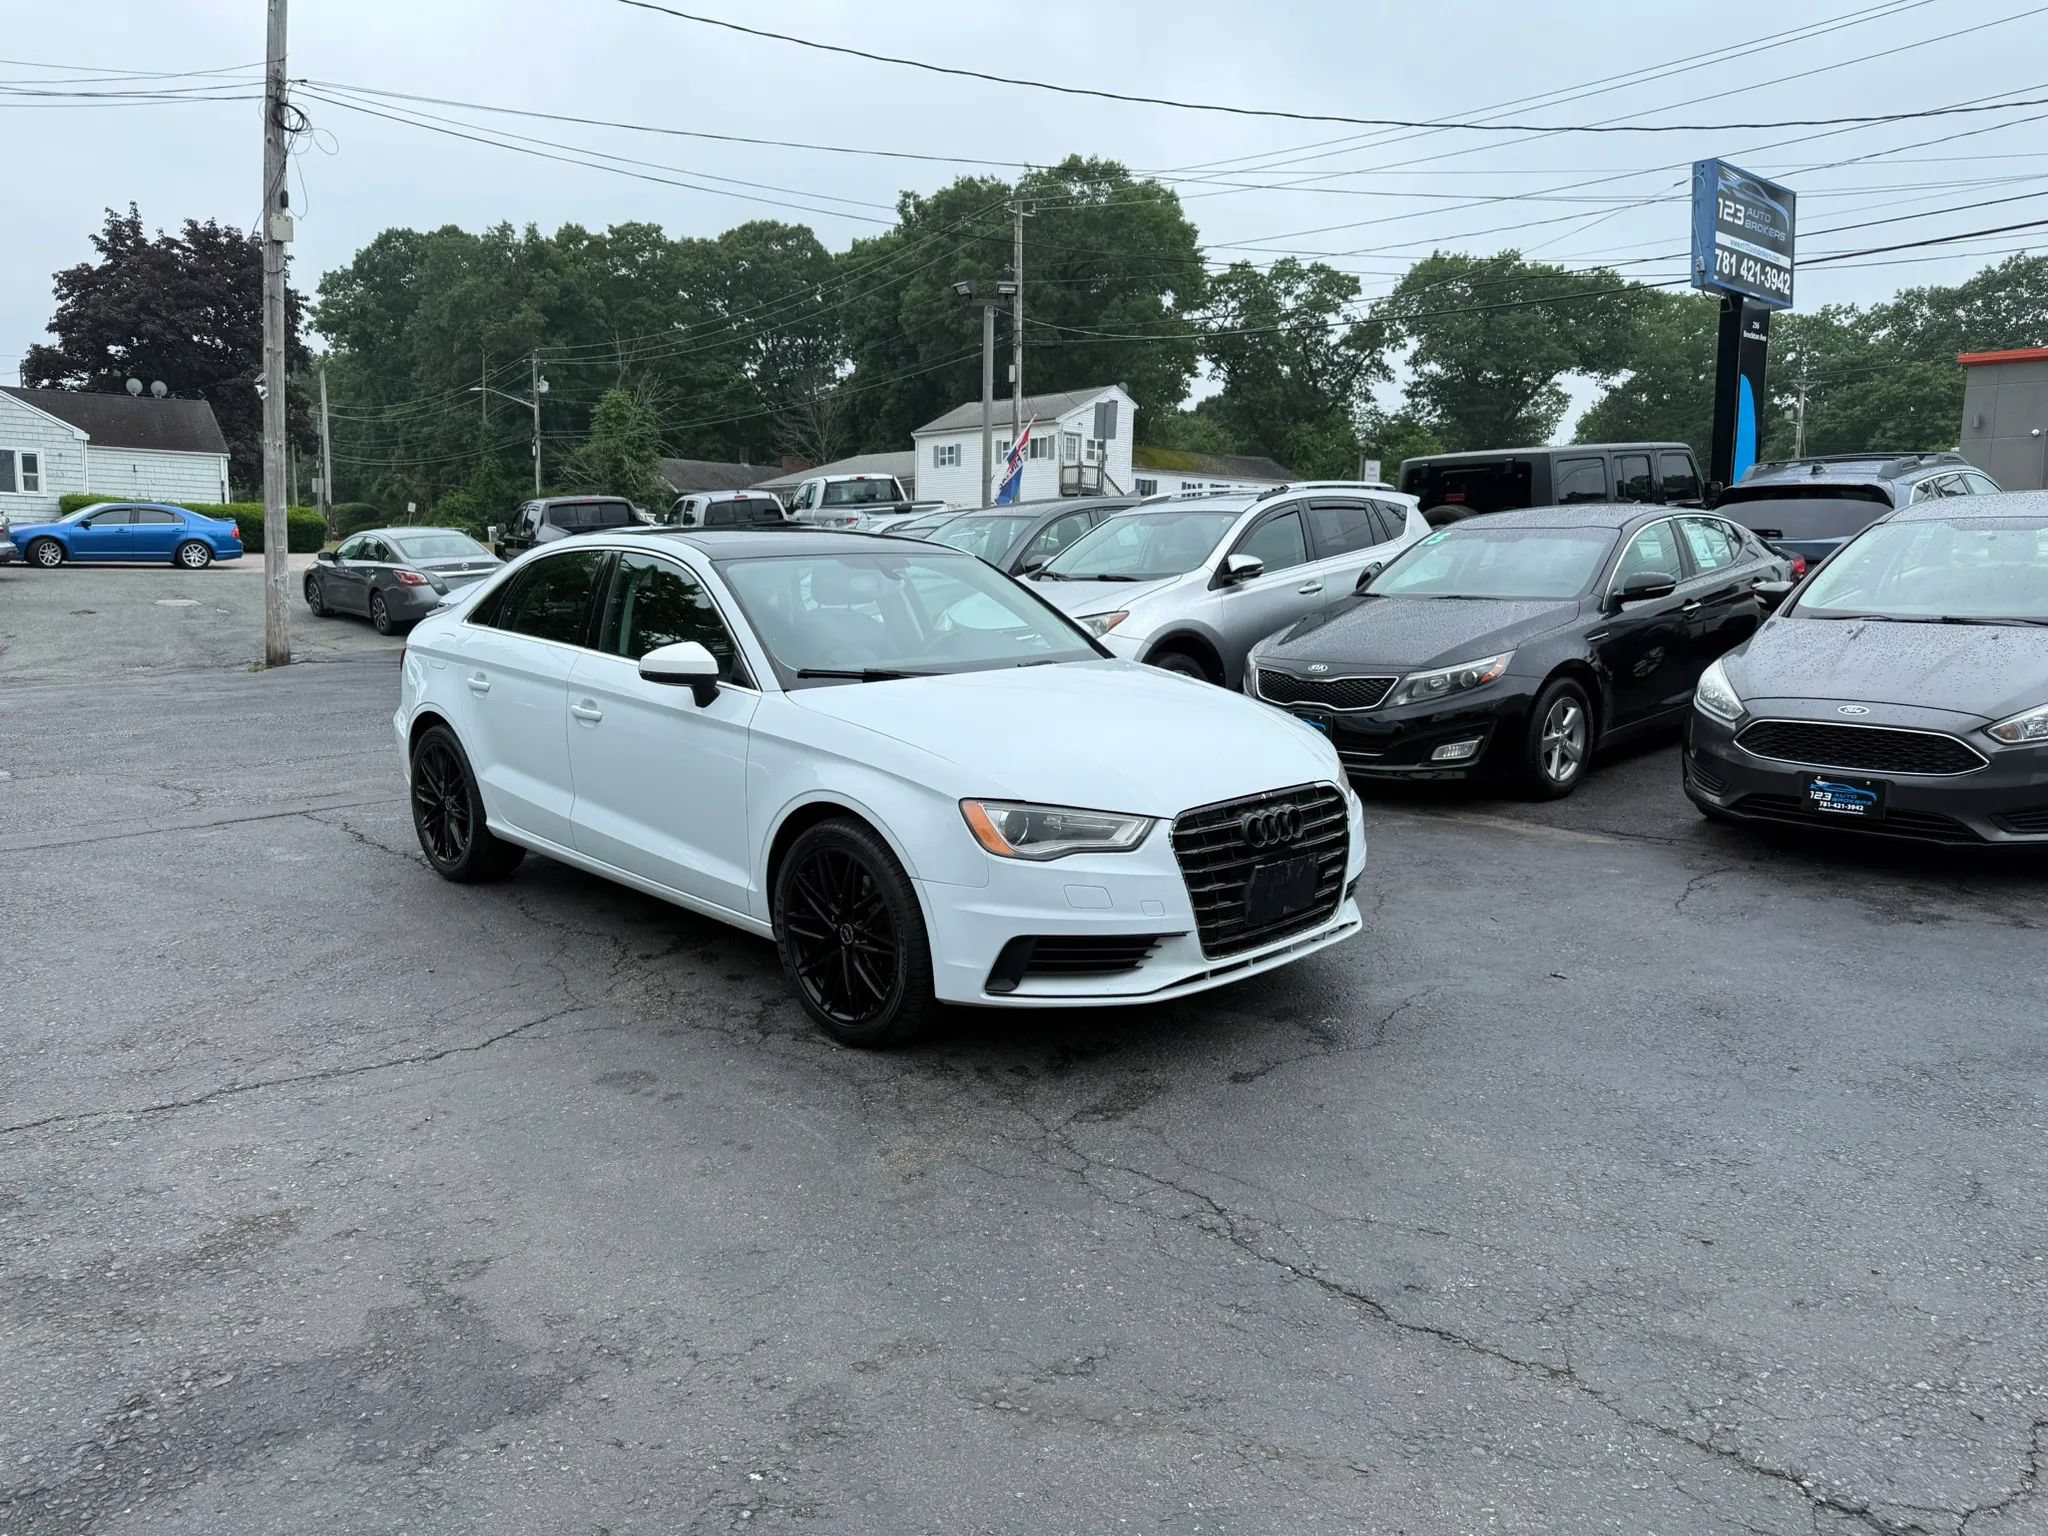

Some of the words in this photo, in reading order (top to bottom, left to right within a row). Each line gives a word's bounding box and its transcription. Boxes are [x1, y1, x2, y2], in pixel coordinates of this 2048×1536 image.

[1717, 198, 1745, 226] 123
[1746, 207, 1772, 224] AUTO
[1744, 219, 1787, 242] BROKERS
[1715, 248, 1736, 277] 781
[1740, 257, 1791, 295] 421-3942
[1309, 664, 1326, 672] KIA
[1809, 790, 1832, 801] 123
[1819, 800, 1864, 812] 781-421-3942
